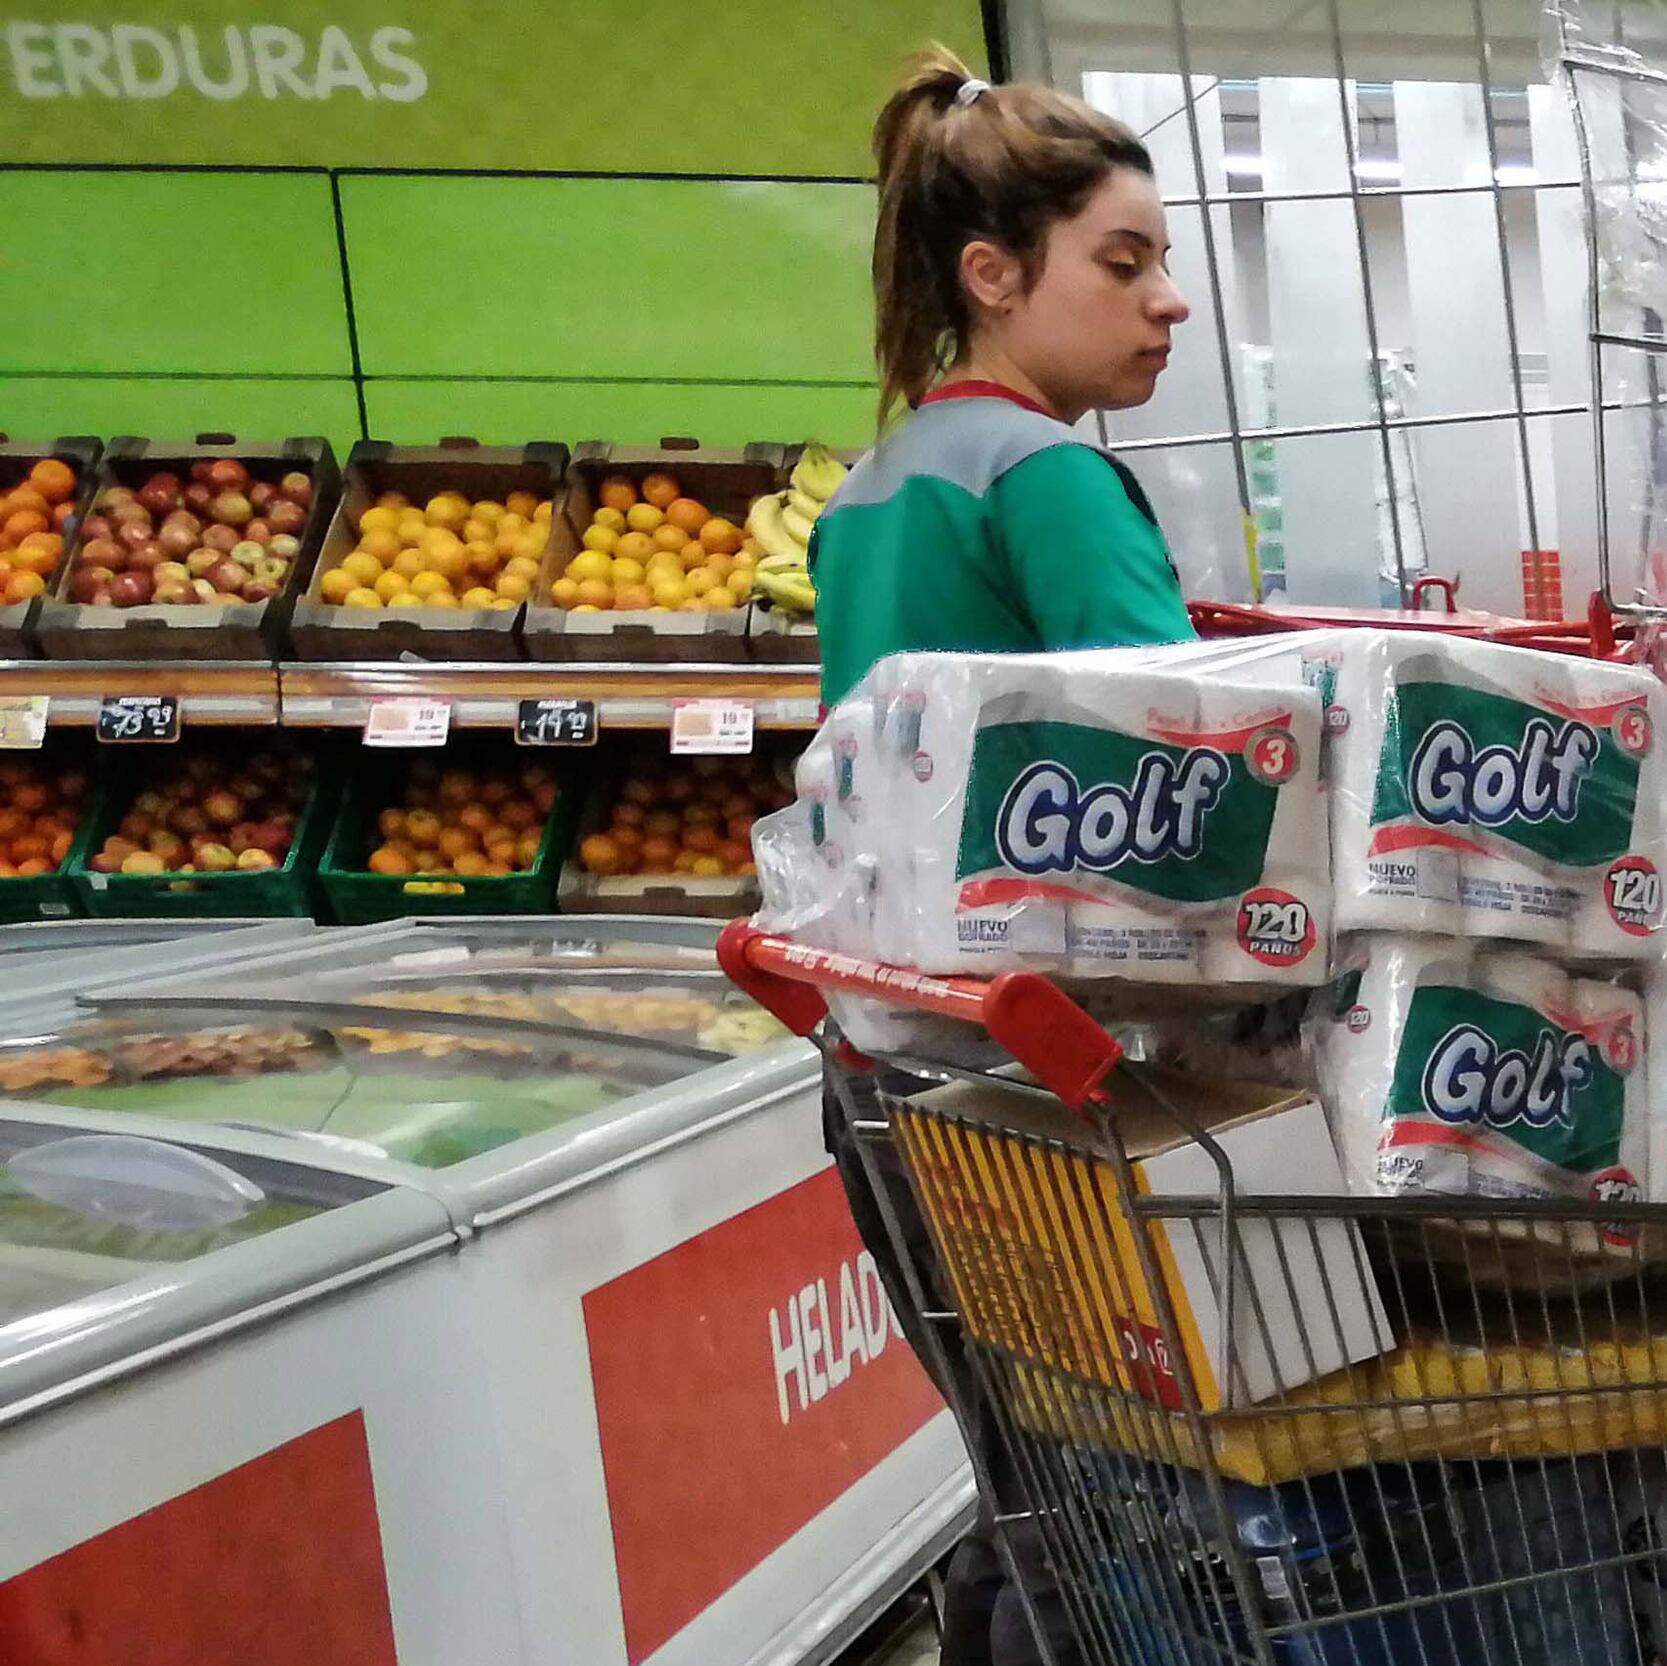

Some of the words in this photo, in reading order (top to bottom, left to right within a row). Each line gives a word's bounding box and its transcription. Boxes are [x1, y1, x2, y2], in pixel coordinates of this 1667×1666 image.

[8, 25, 428, 103] ERDURAS
[1263, 741, 1285, 768] 3
[1628, 714, 1644, 748] 3
[1409, 718, 1597, 826] Golf
[998, 748, 1230, 875] Golf
[1611, 869, 1662, 912] 120
[1243, 901, 1308, 943] 120
[1421, 1024, 1592, 1128] Golf
